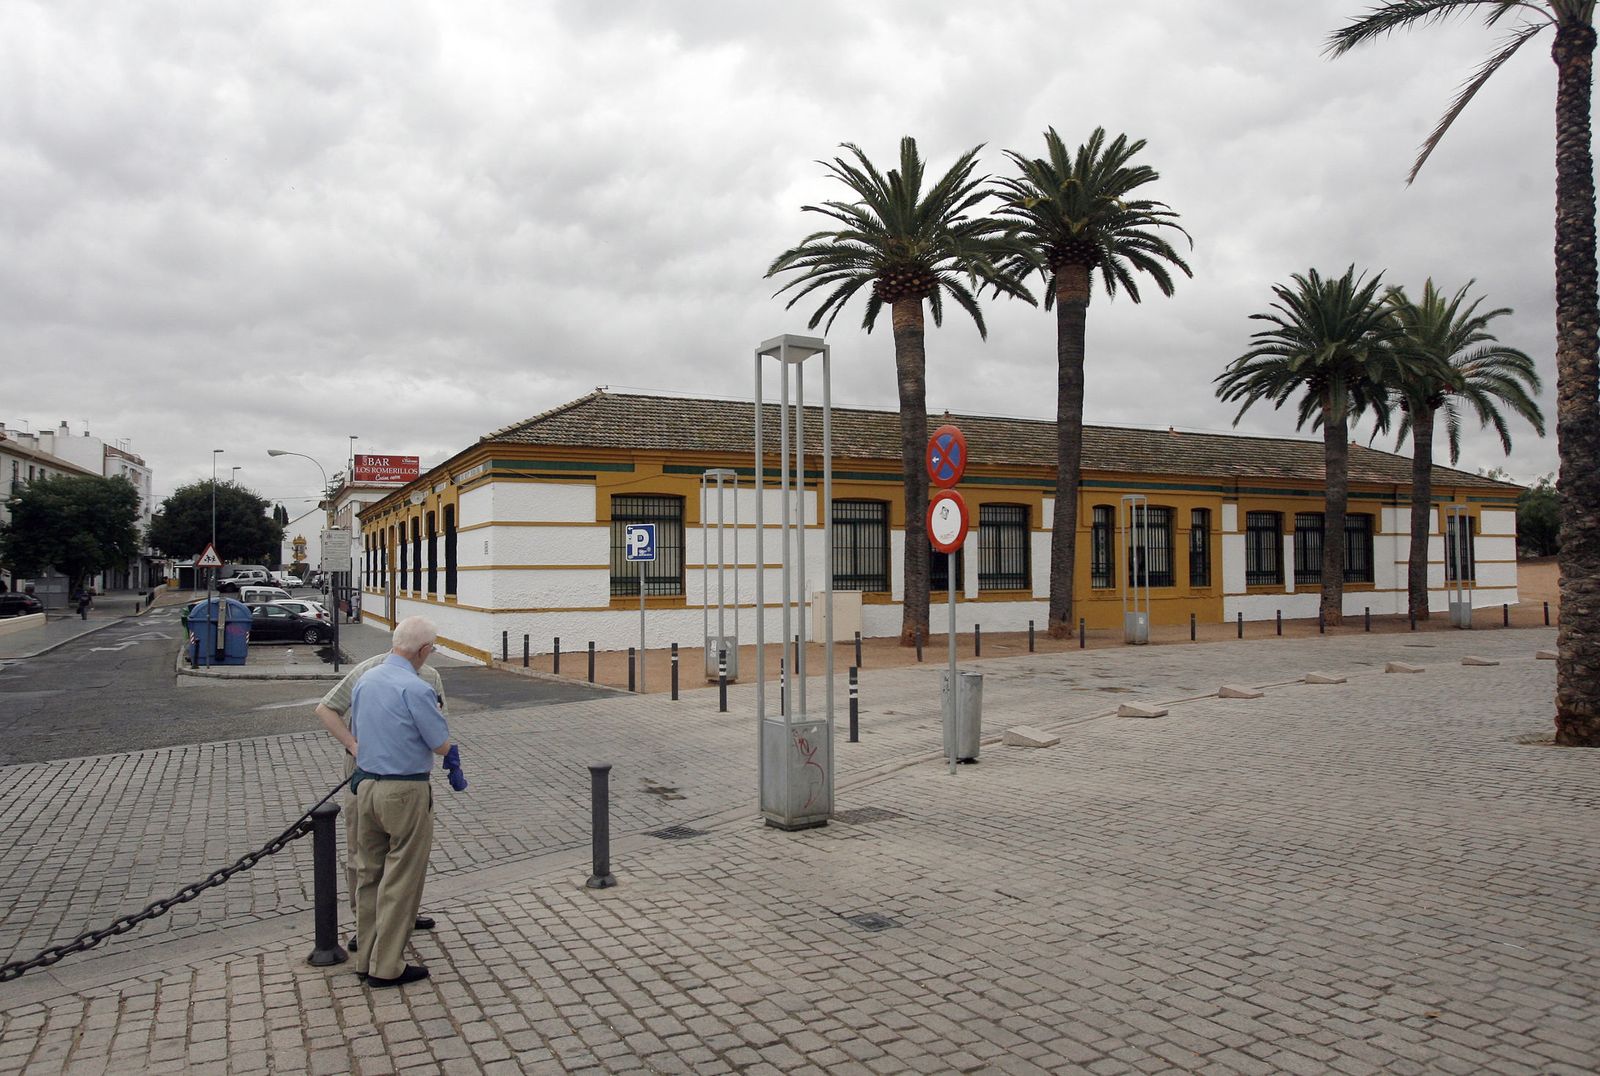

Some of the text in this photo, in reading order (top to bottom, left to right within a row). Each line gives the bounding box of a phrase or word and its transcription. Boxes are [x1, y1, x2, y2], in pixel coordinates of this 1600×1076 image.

[368, 457, 390, 466] BAR
[356, 466, 418, 475] LOS ROMERILLOS
[632, 529, 650, 556] P
